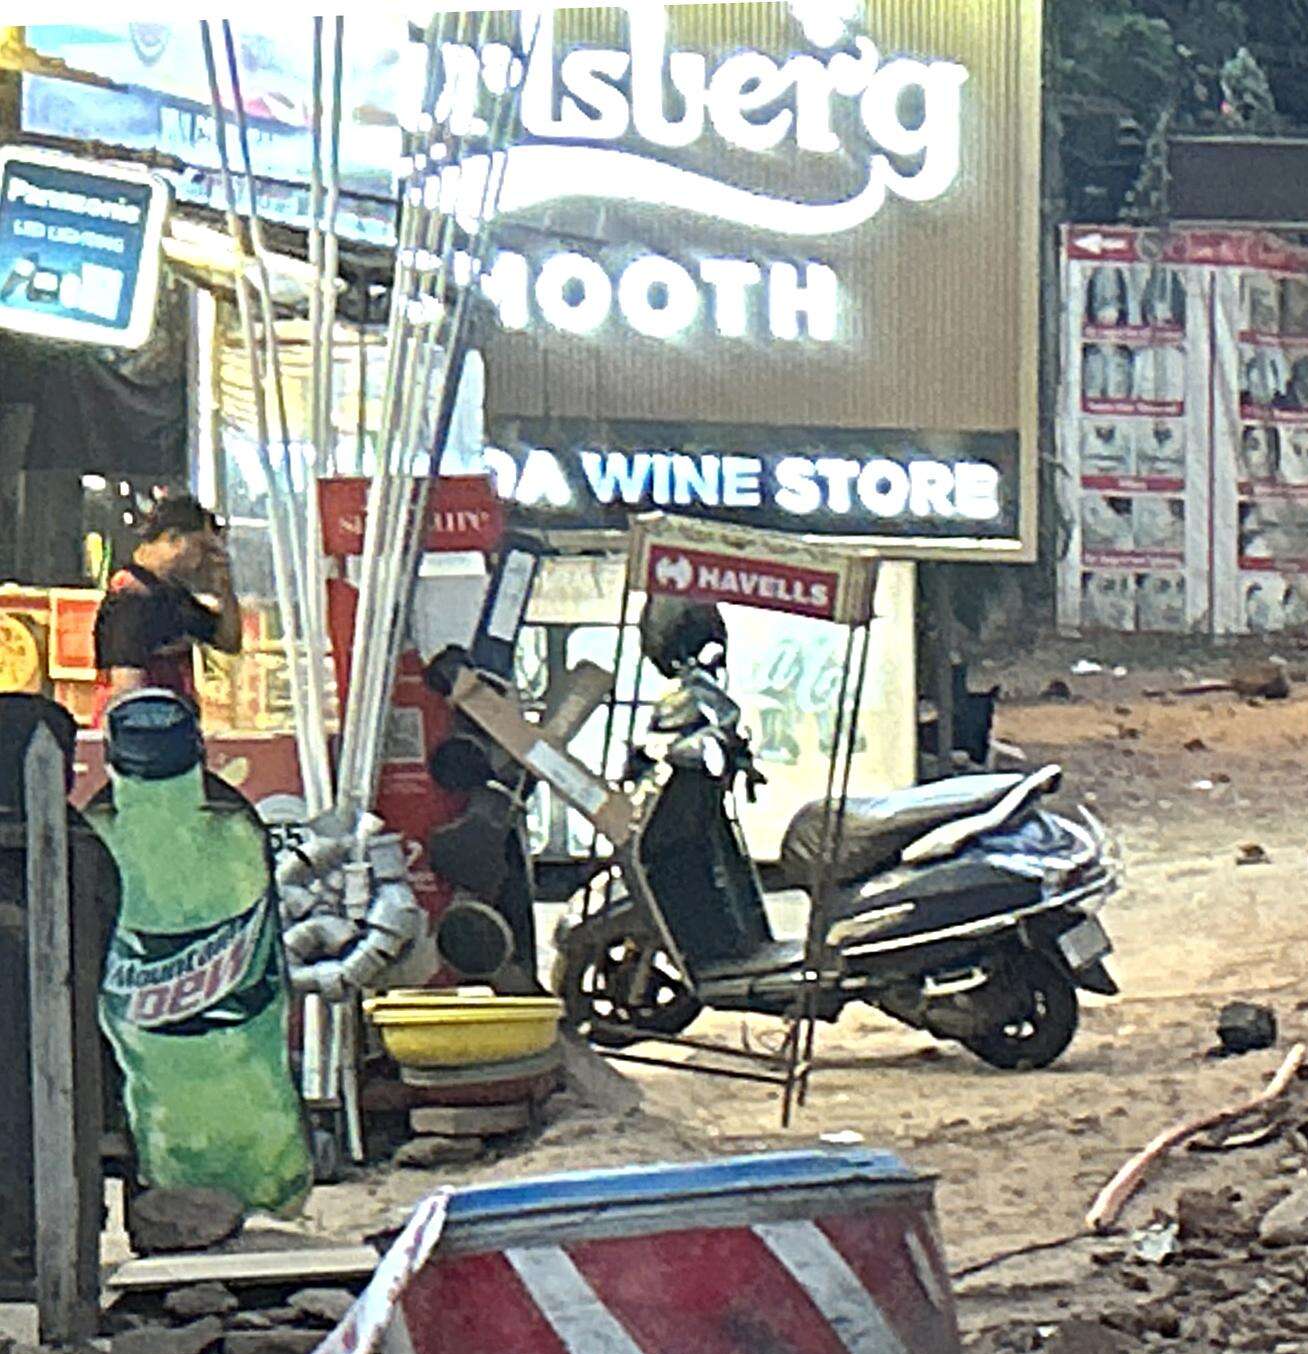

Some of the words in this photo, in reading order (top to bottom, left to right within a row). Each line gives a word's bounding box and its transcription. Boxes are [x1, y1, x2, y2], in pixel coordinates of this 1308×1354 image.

[579, 449, 761, 507] WINE
[774, 456, 1000, 520] STORE
[696, 565, 829, 608] HAVELLS
